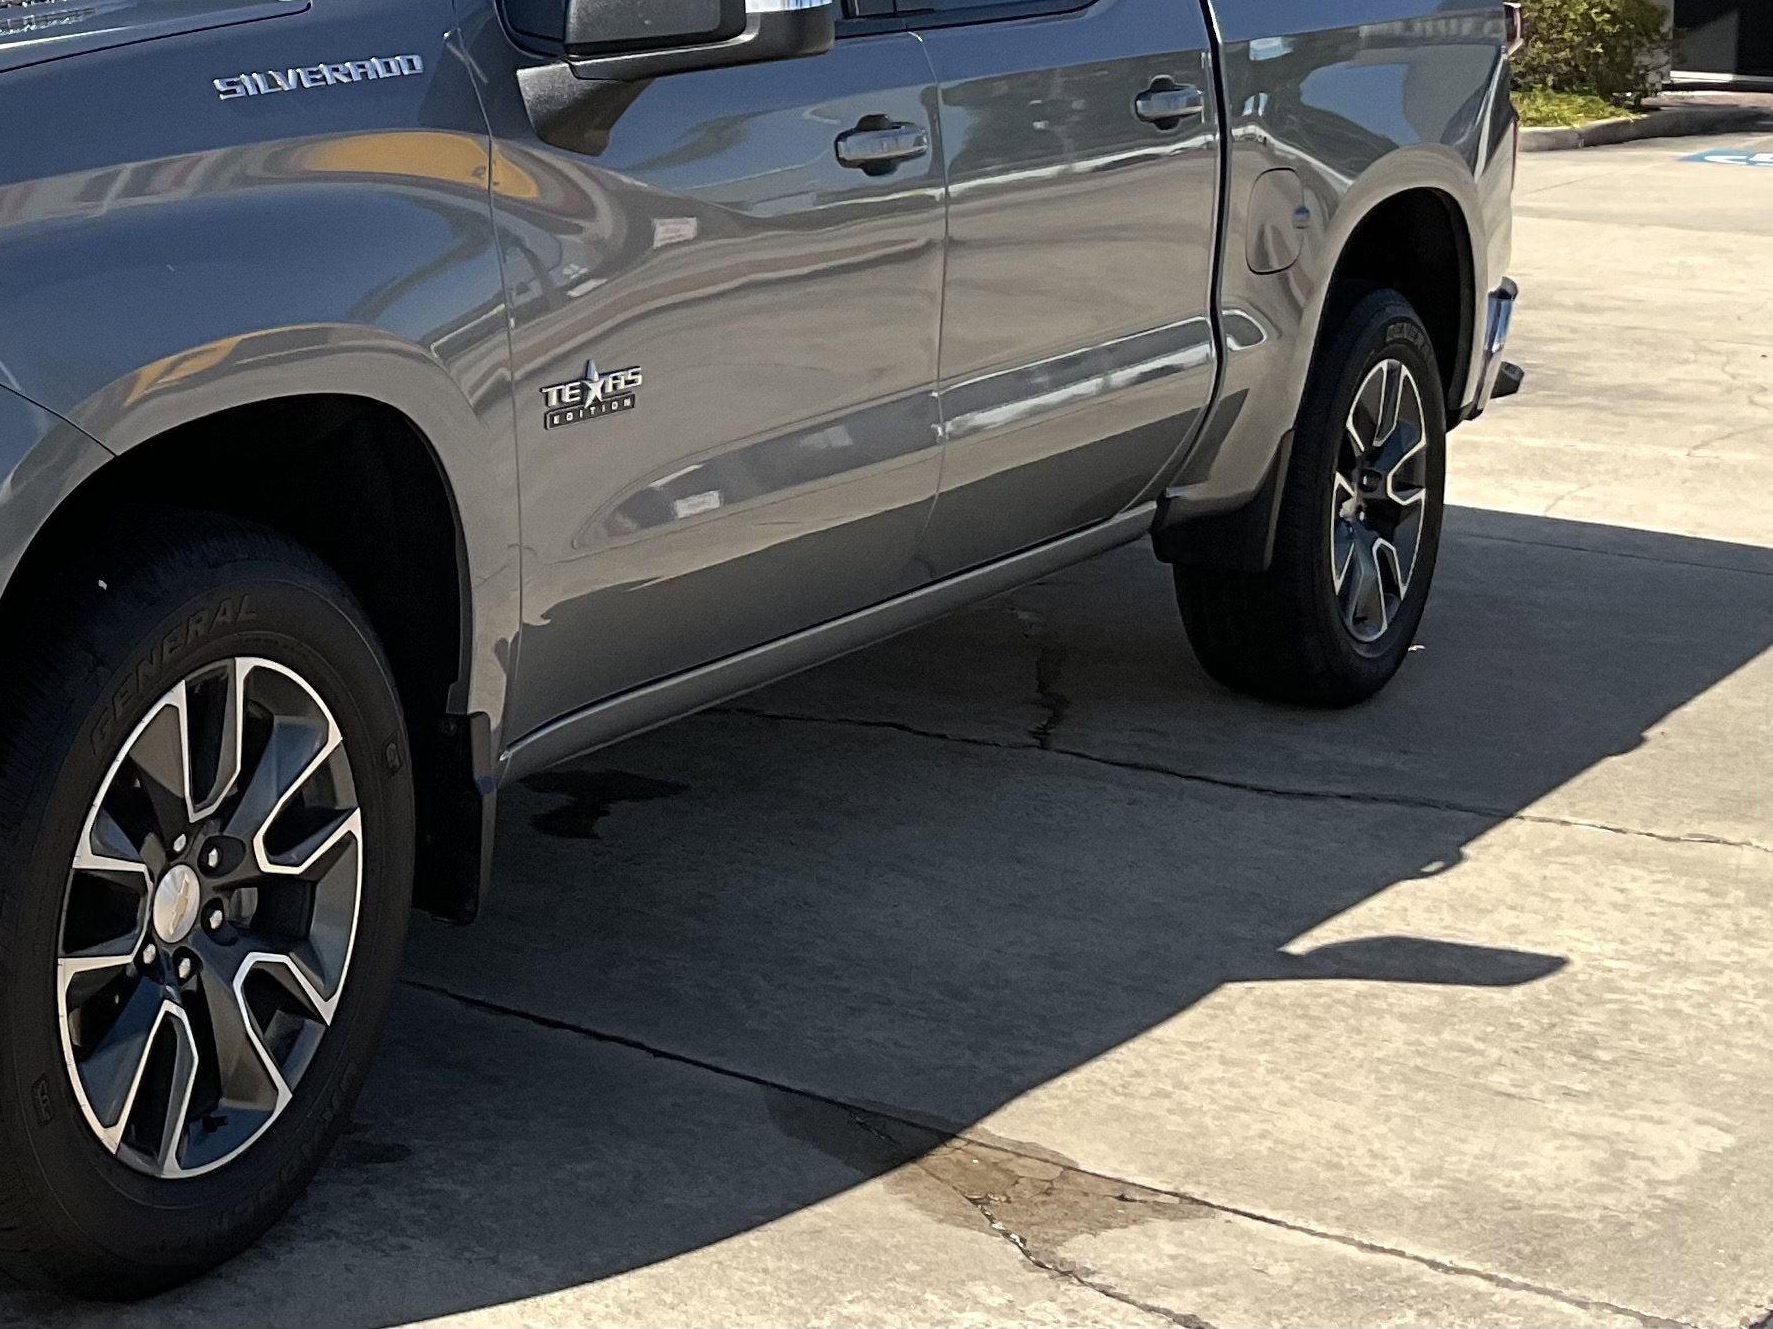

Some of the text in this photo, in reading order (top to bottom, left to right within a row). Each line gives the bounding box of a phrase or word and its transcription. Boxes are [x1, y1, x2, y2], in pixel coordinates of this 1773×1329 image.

[213, 54, 425, 100] SILVERADO
[540, 359, 643, 407] TEXAS
[553, 397, 632, 425] EDITION
[89, 593, 259, 758] GENERAL
